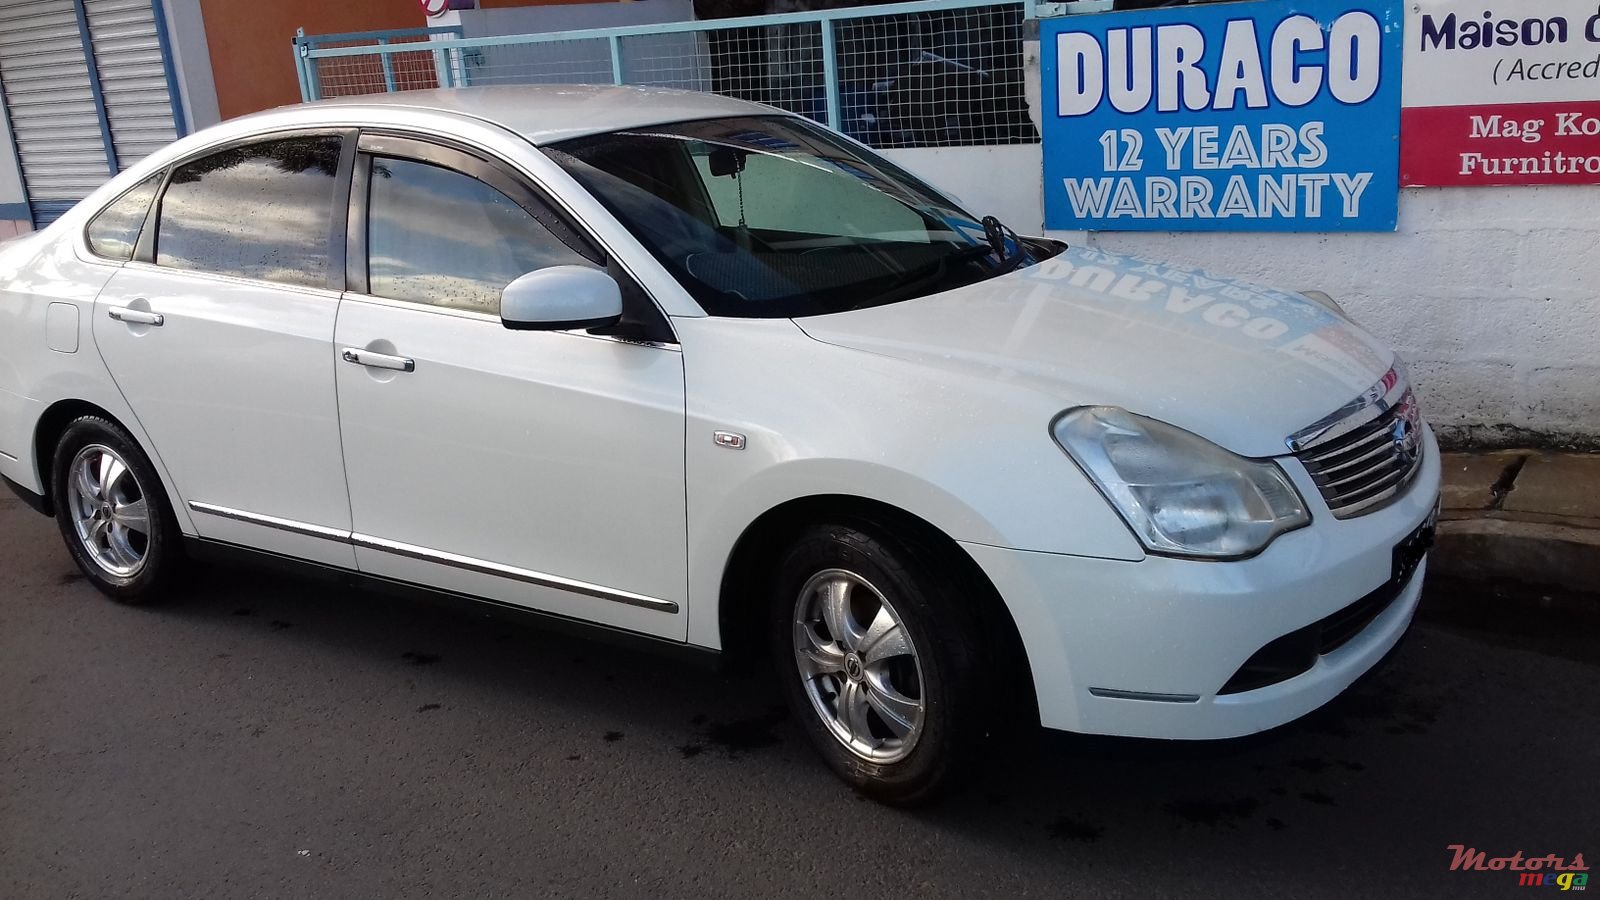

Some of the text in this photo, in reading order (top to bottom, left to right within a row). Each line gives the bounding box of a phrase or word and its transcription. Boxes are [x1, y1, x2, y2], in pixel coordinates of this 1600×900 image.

[1421, 11, 1567, 51] Maison
[1057, 12, 1380, 117] DURACO
[1099, 121, 1327, 172] 12 YEARS
[1469, 115, 1544, 143] Mag
[1063, 172, 1373, 219] WARRANTY
